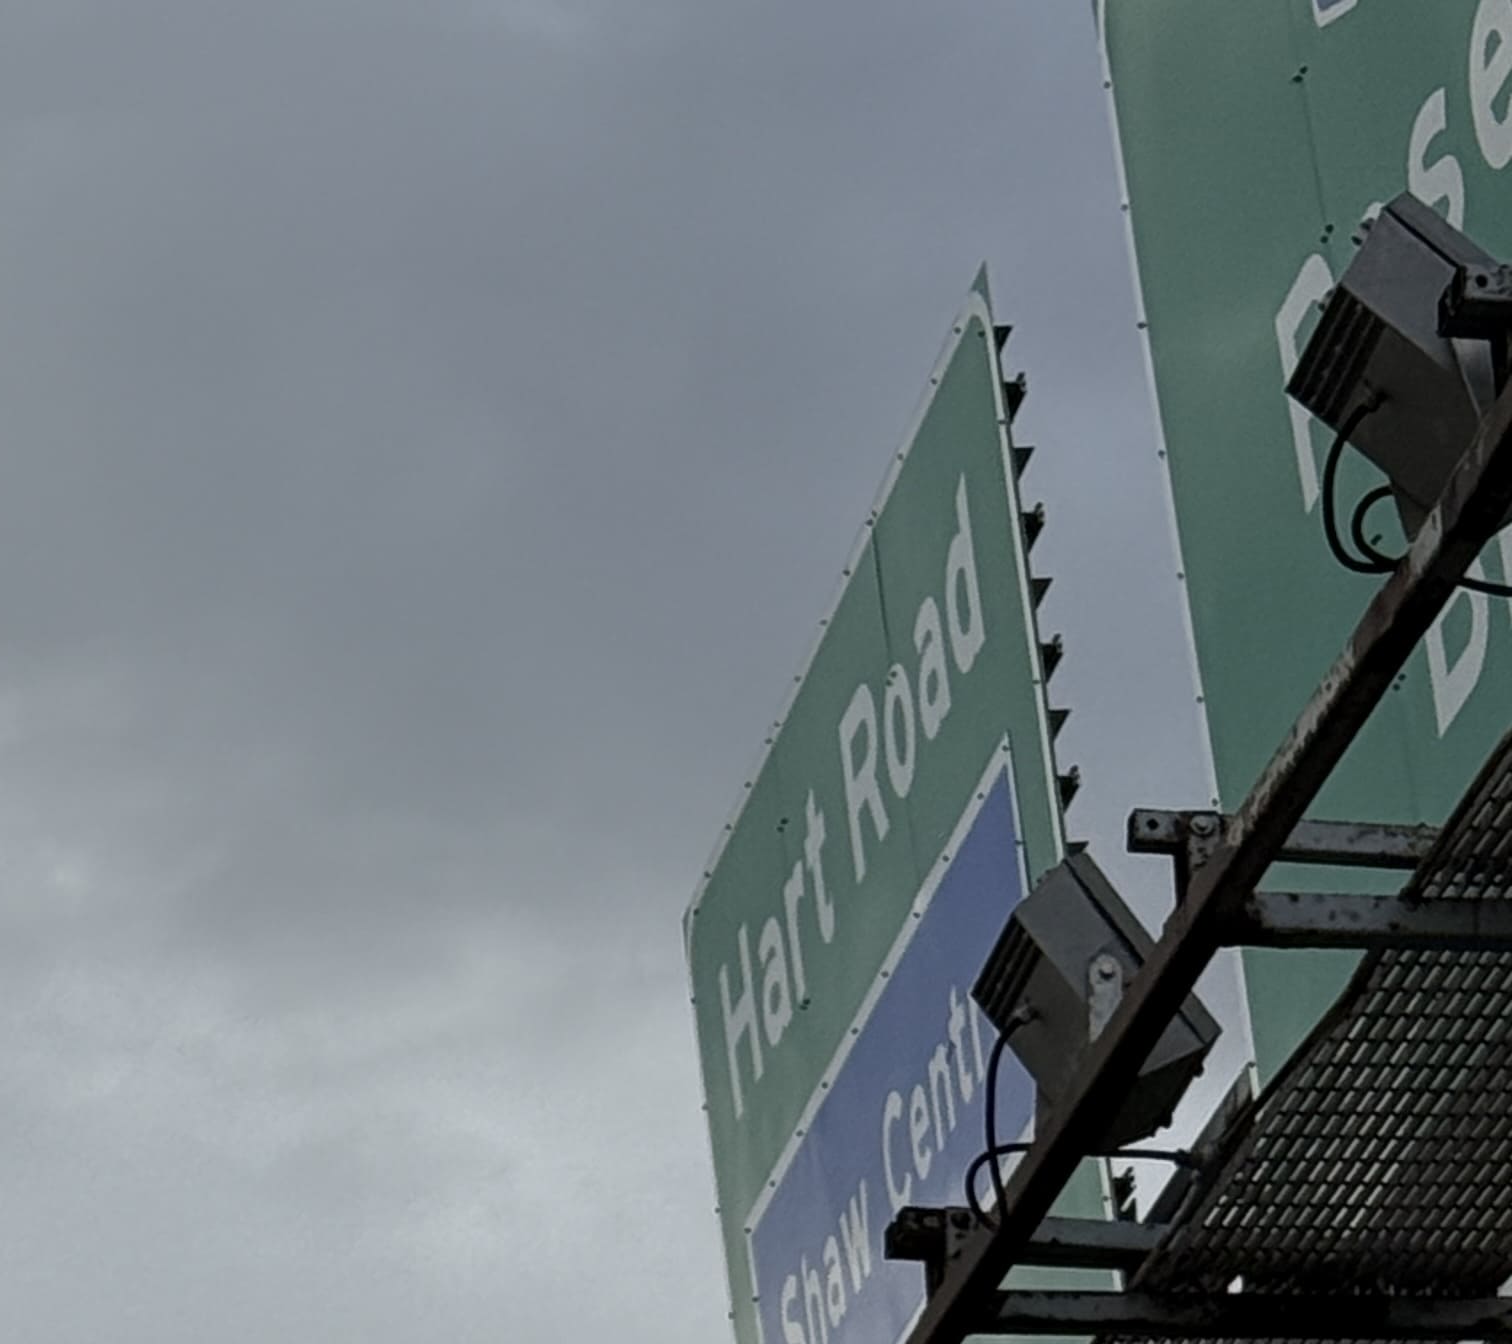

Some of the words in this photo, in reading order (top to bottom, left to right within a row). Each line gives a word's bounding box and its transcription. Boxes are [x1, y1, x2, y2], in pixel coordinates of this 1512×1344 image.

[719, 788, 835, 1120] Hart
[839, 473, 985, 883] Road
[883, 984, 986, 1214] Centr
